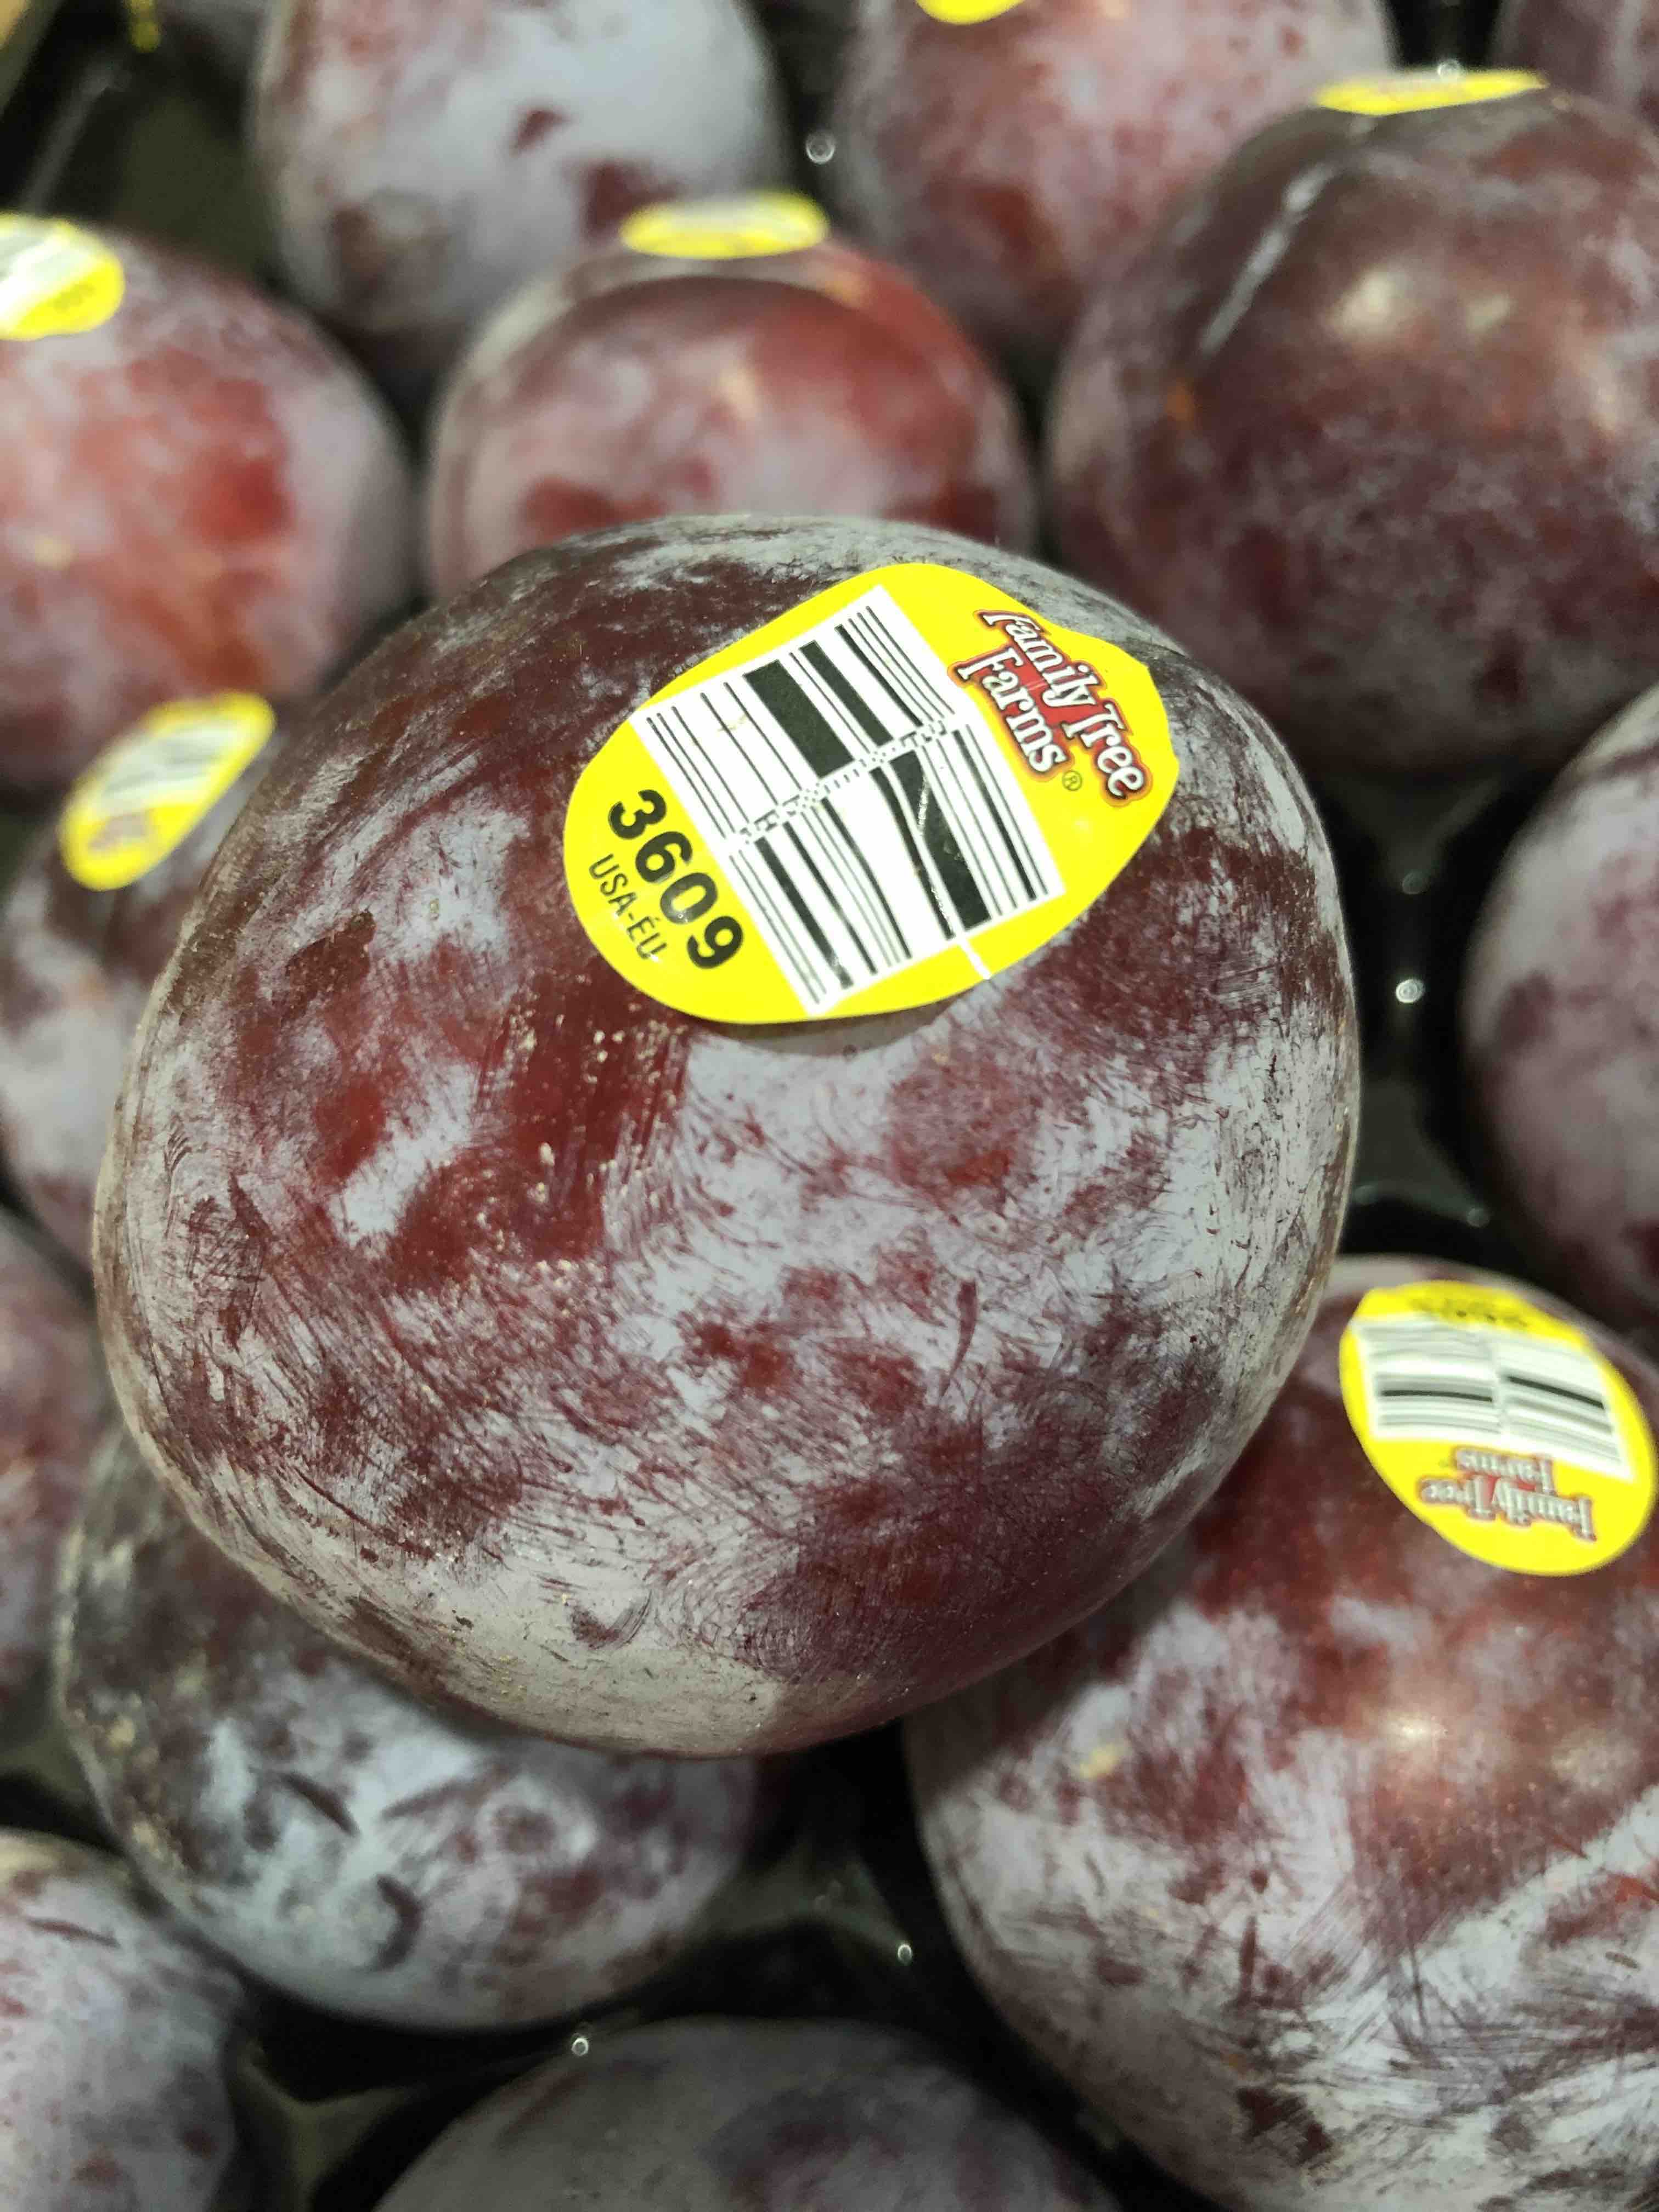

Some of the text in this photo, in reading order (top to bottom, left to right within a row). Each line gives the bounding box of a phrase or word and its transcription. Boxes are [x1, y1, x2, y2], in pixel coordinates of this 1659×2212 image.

[953, 645, 1070, 774] Farms
[978, 610, 1147, 799] Family Tree
[607, 789, 744, 969] 3609
[1420, 1476, 1594, 1541] Family Tree
[1456, 1449, 1553, 1494] Farms
